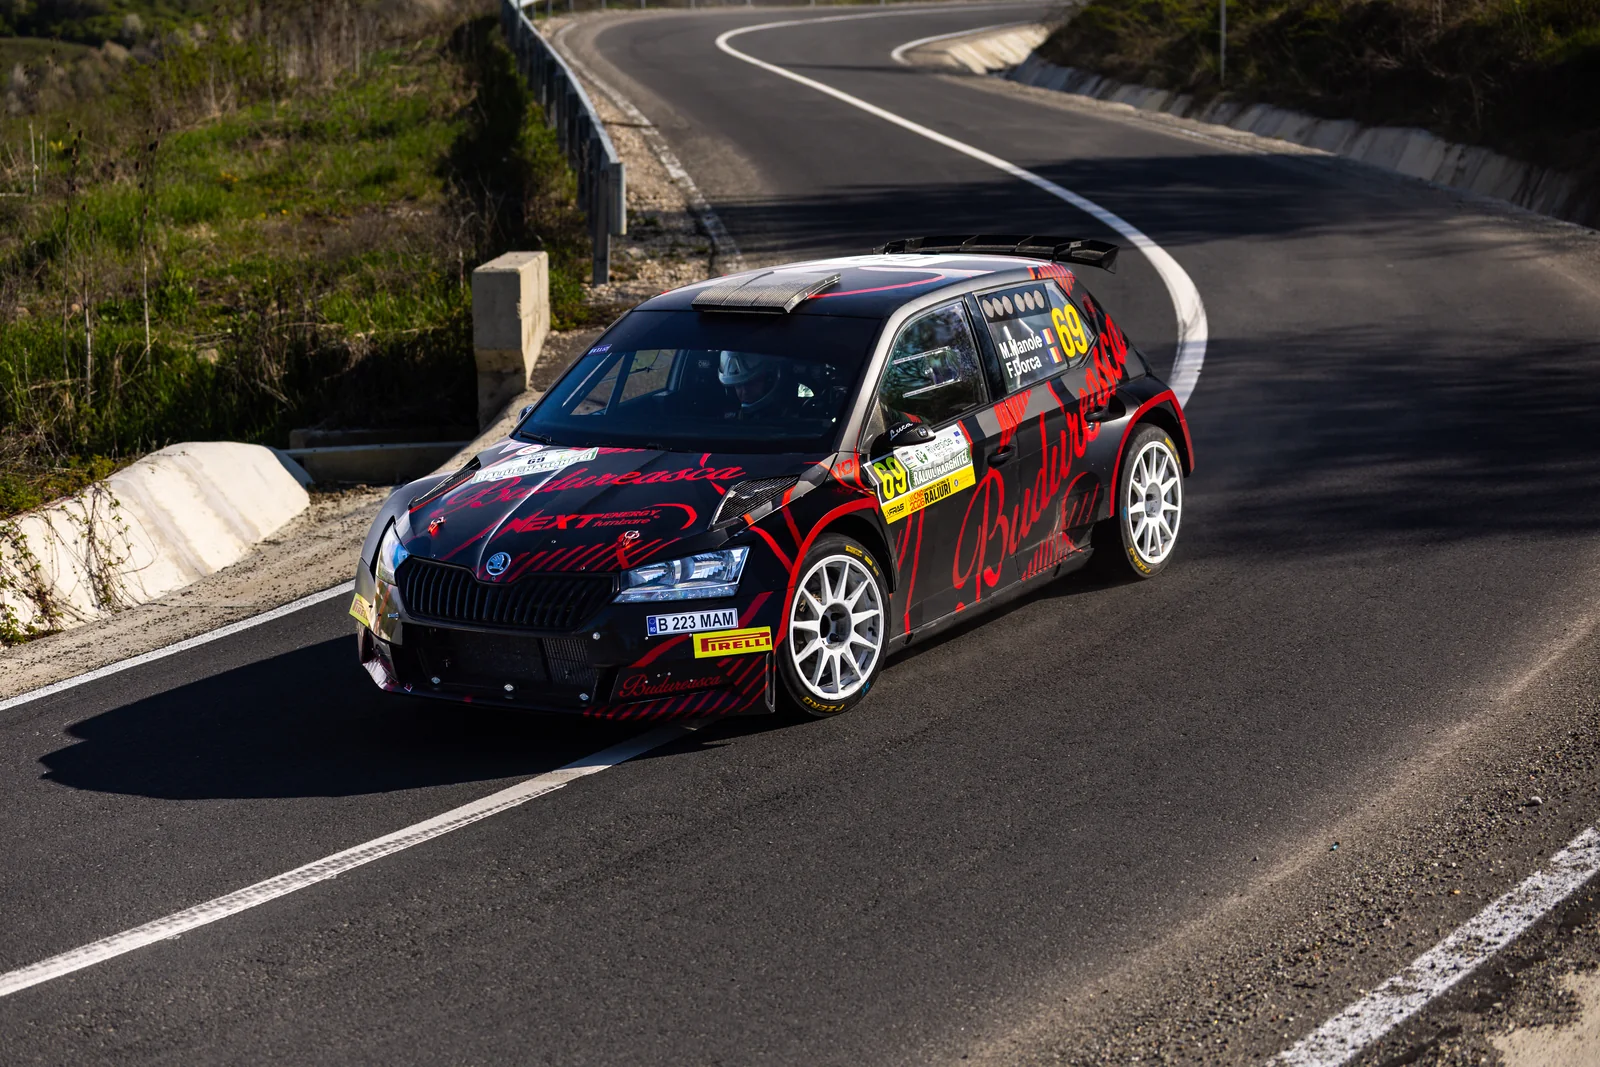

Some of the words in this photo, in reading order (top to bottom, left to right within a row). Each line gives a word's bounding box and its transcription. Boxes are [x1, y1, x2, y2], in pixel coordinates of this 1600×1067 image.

[1051, 303, 1088, 358] 69
[998, 333, 1043, 359] M.Manole
[1005, 355, 1043, 379] F.Dorca
[925, 437, 954, 454] Riverside
[527, 457, 546, 465] 69
[953, 313, 1128, 612] Budureasca
[873, 456, 907, 500] 69
[913, 468, 937, 486] RALIUL
[429, 465, 746, 519] Budureasca
[924, 482, 952, 505] RALIURI
[601, 509, 662, 519] ENERGY
[488, 509, 602, 544] NEXT
[658, 617, 668, 632] B
[672, 615, 696, 631] 223
[700, 611, 734, 628] MAM
[700, 631, 771, 653] PIRELLI
[618, 673, 722, 698] Budureasca
